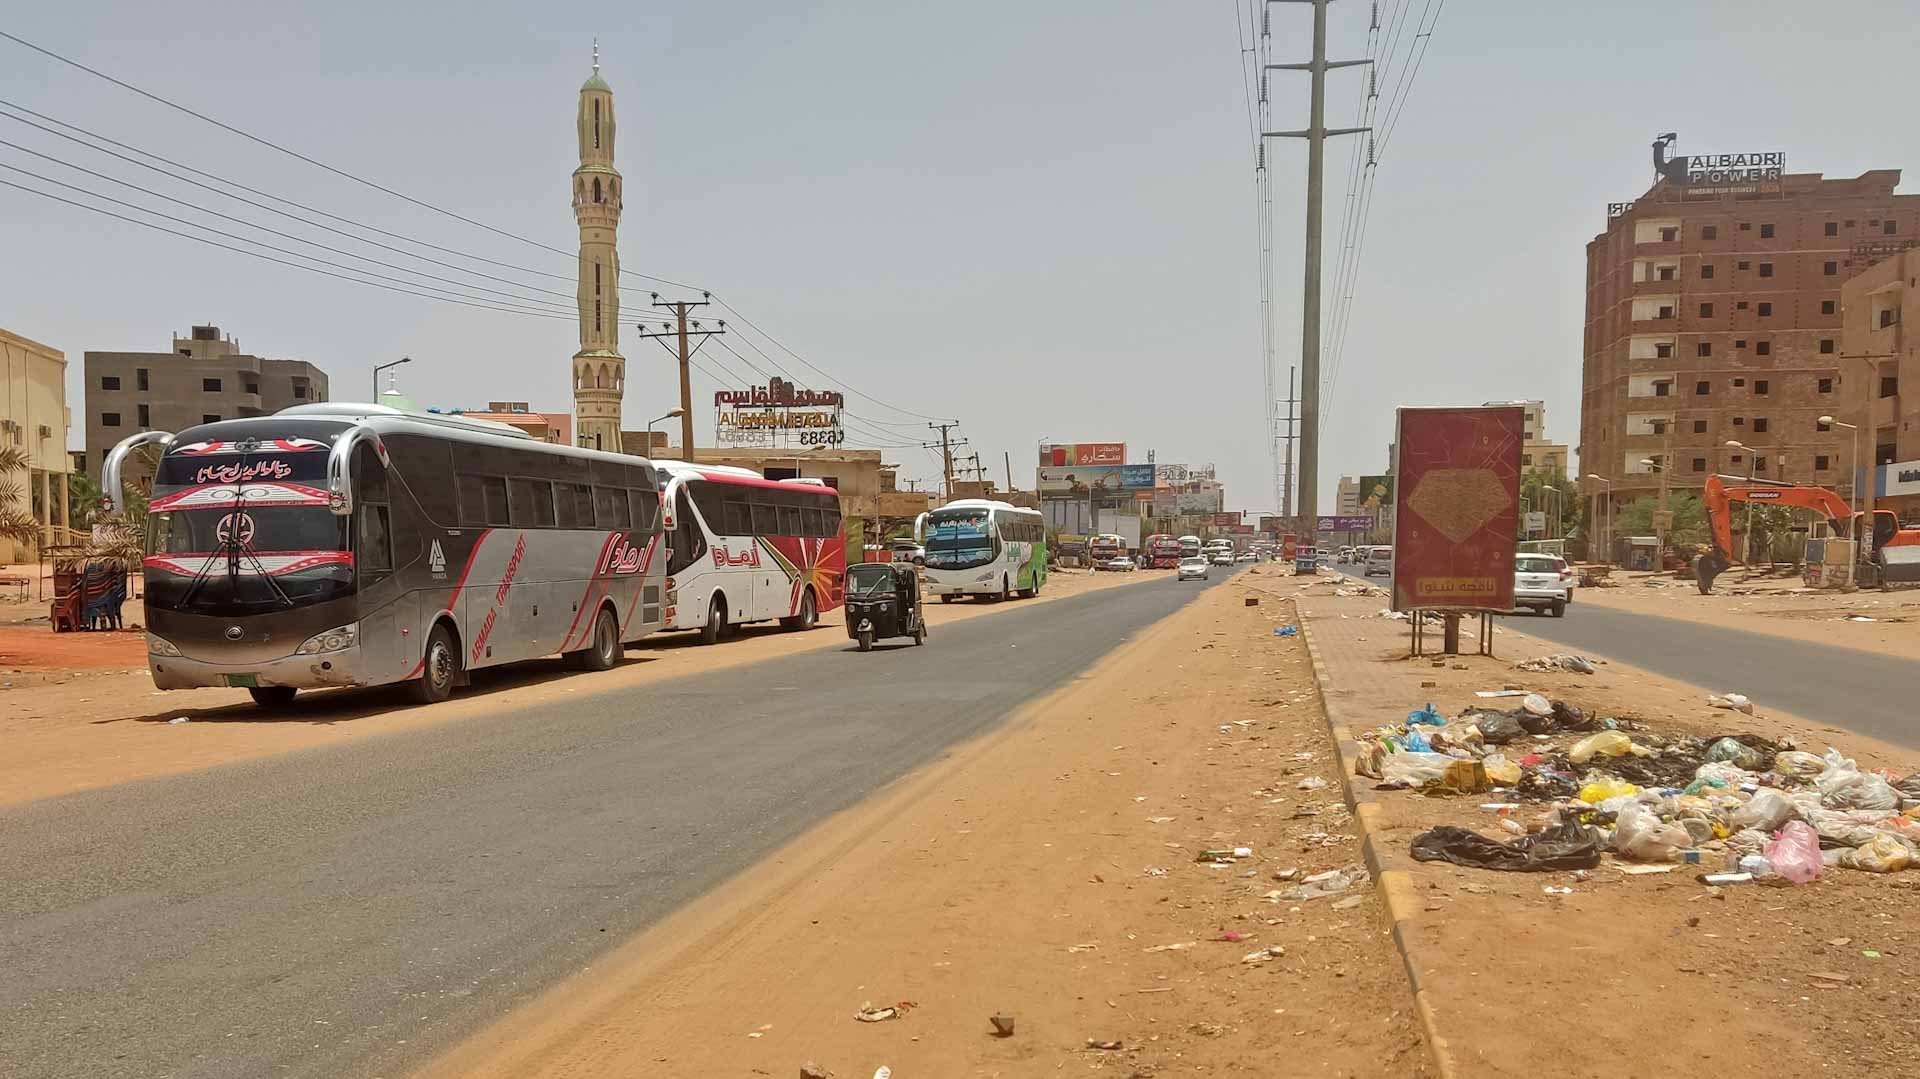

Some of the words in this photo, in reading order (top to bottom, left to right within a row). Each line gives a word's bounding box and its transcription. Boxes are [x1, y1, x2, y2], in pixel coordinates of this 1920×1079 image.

[1691, 152, 1781, 169] ALBADRI
[1692, 168, 1778, 183] POWER
[472, 607, 497, 665] ARMADA
[496, 532, 527, 607] TRANSPORT
